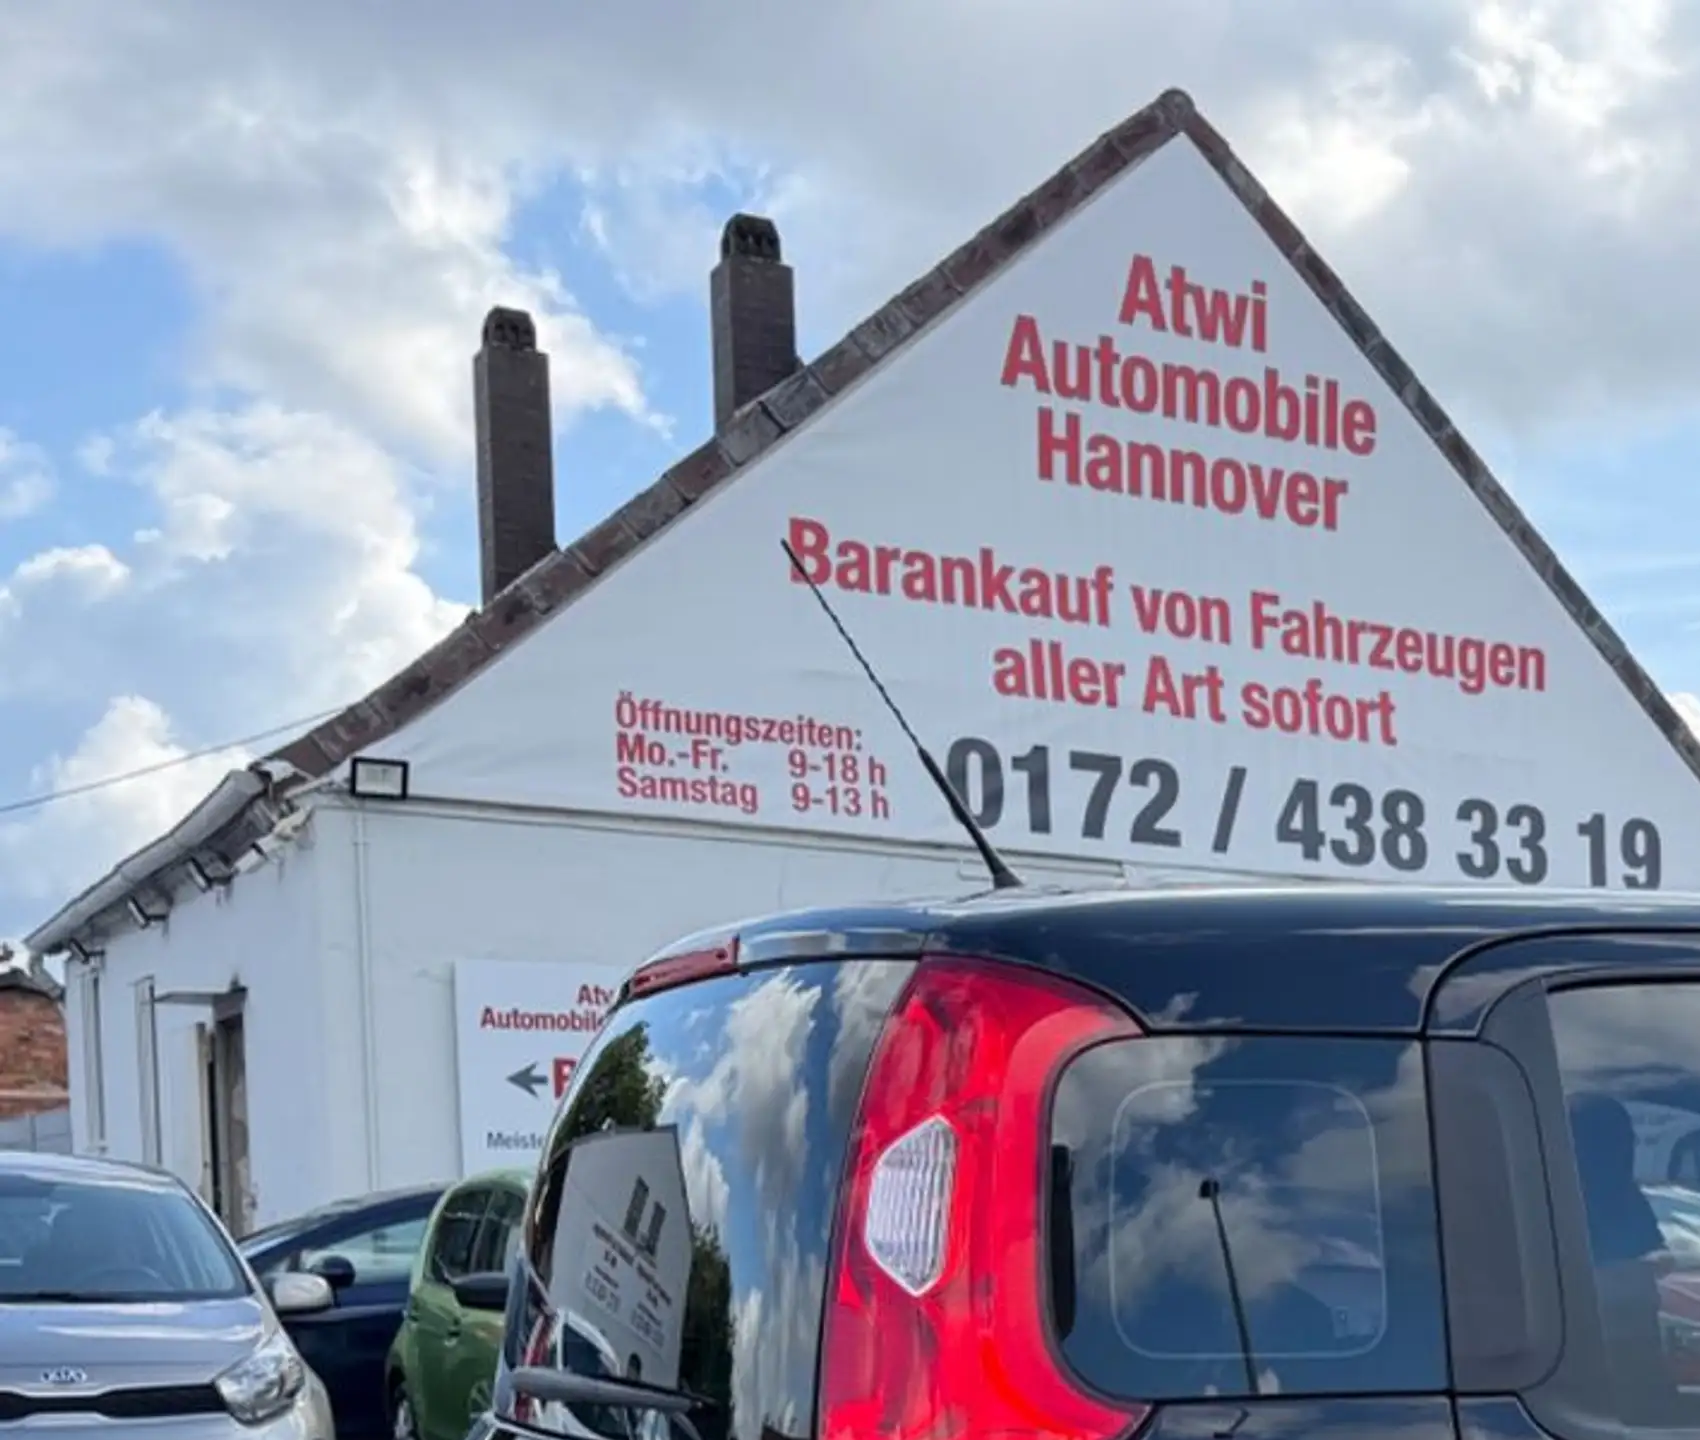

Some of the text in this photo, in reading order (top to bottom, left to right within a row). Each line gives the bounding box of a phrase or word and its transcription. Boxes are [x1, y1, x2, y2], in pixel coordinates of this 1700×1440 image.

[1119, 254, 1266, 352] Atwi
[1001, 314, 1377, 455] Automobile
[1037, 407, 1348, 530] Hannover
[789, 517, 1545, 695] Barankauf von Fahrzeugen
[615, 691, 862, 751] Öffnungszeiten:
[992, 639, 1398, 745] aller Art sofort
[616, 733, 886, 787] Mo.-Fr. 9-18 h
[617, 768, 890, 819] Samstag 9-13 h
[945, 737, 1661, 891] 0172 / 438 33 19
[480, 1007, 605, 1032] Automobil
